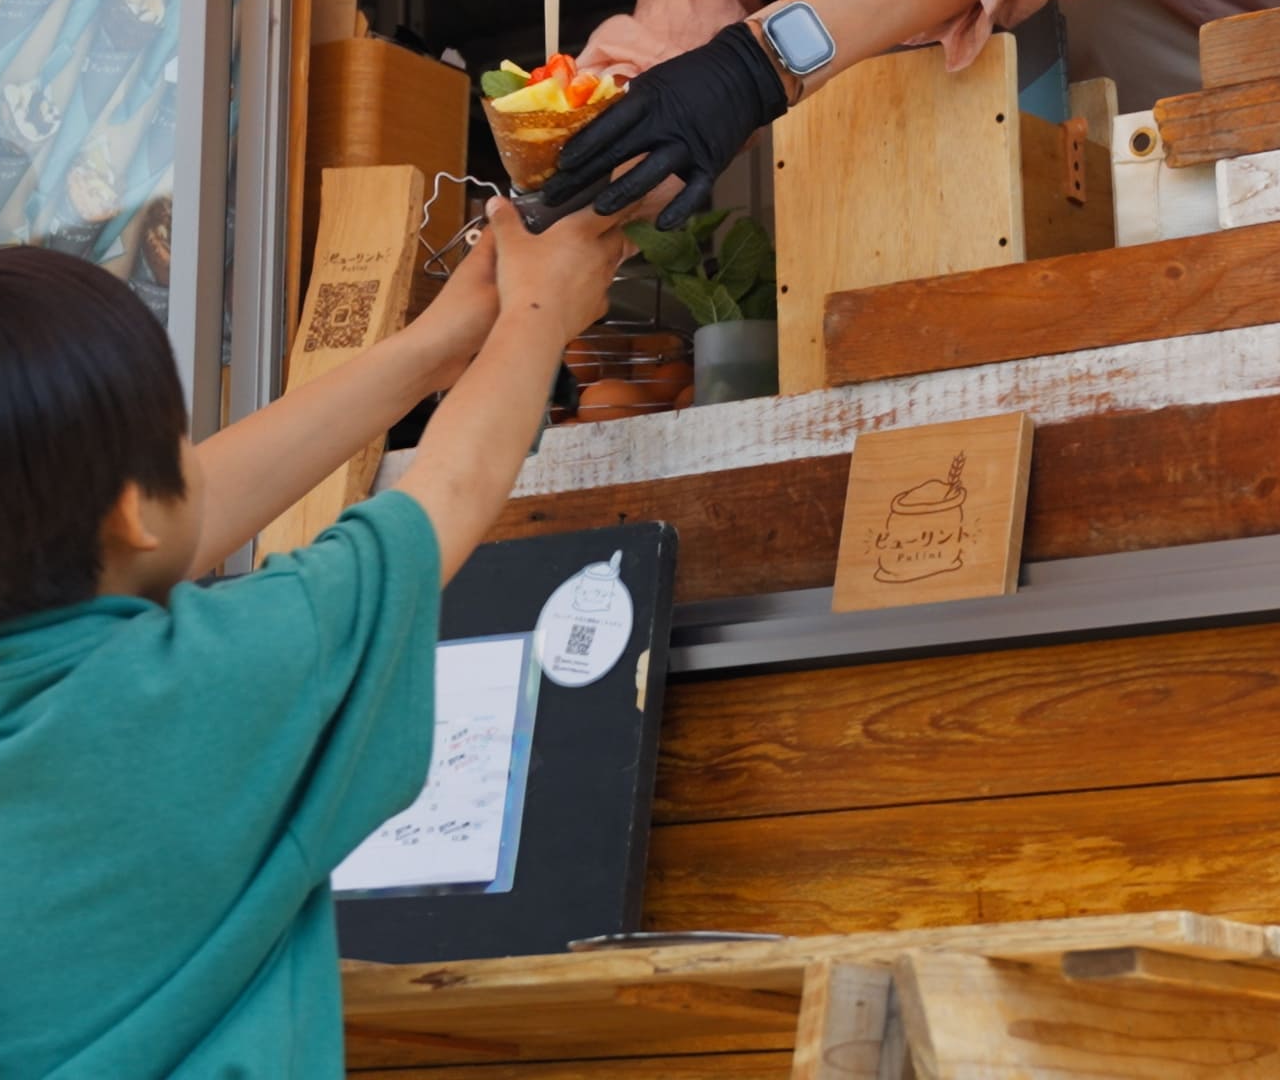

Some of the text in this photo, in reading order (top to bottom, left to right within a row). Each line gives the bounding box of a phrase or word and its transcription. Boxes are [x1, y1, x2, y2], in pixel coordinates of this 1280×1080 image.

[875, 526, 970, 550] ピューリント
